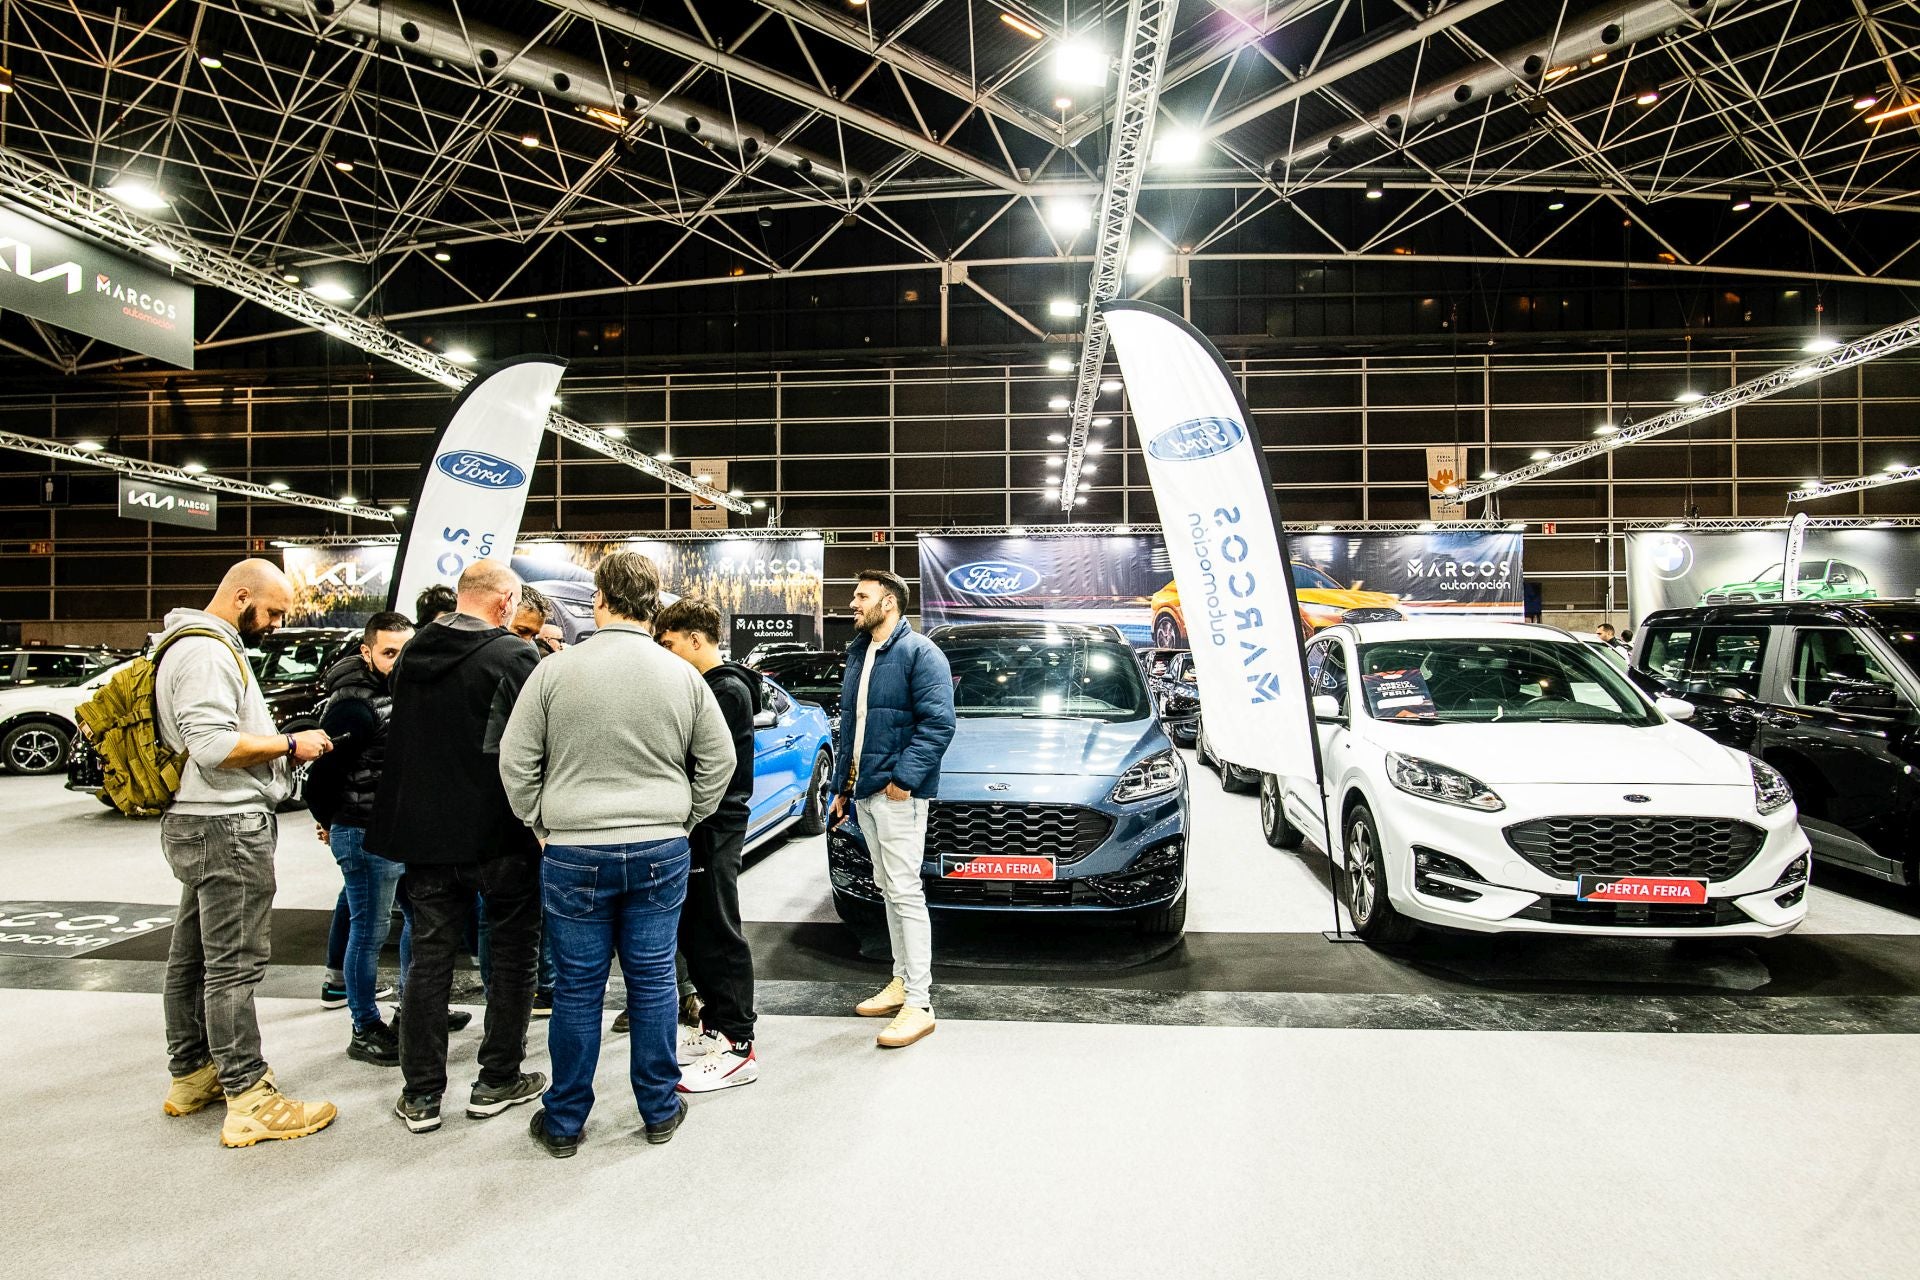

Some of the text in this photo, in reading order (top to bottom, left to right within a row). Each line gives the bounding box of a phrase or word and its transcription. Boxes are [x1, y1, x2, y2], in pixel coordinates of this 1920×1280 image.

[0, 236, 82, 295] IA
[96, 273, 176, 320] MARCOS
[452, 454, 511, 485] Ford
[128, 489, 175, 511] KIA
[177, 497, 210, 512] MARCOS
[719, 556, 815, 576] MARCOS
[1407, 559, 1511, 578] MARCOS
[963, 565, 1023, 591] Ford
[1439, 580, 1511, 590] automoción
[735, 618, 794, 631] MARCOS
[753, 629, 794, 637] automoción
[953, 862, 1042, 875] OFERTA FERIA
[1595, 882, 1692, 897] OFERTA FERIA
[0, 912, 172, 933] COS
